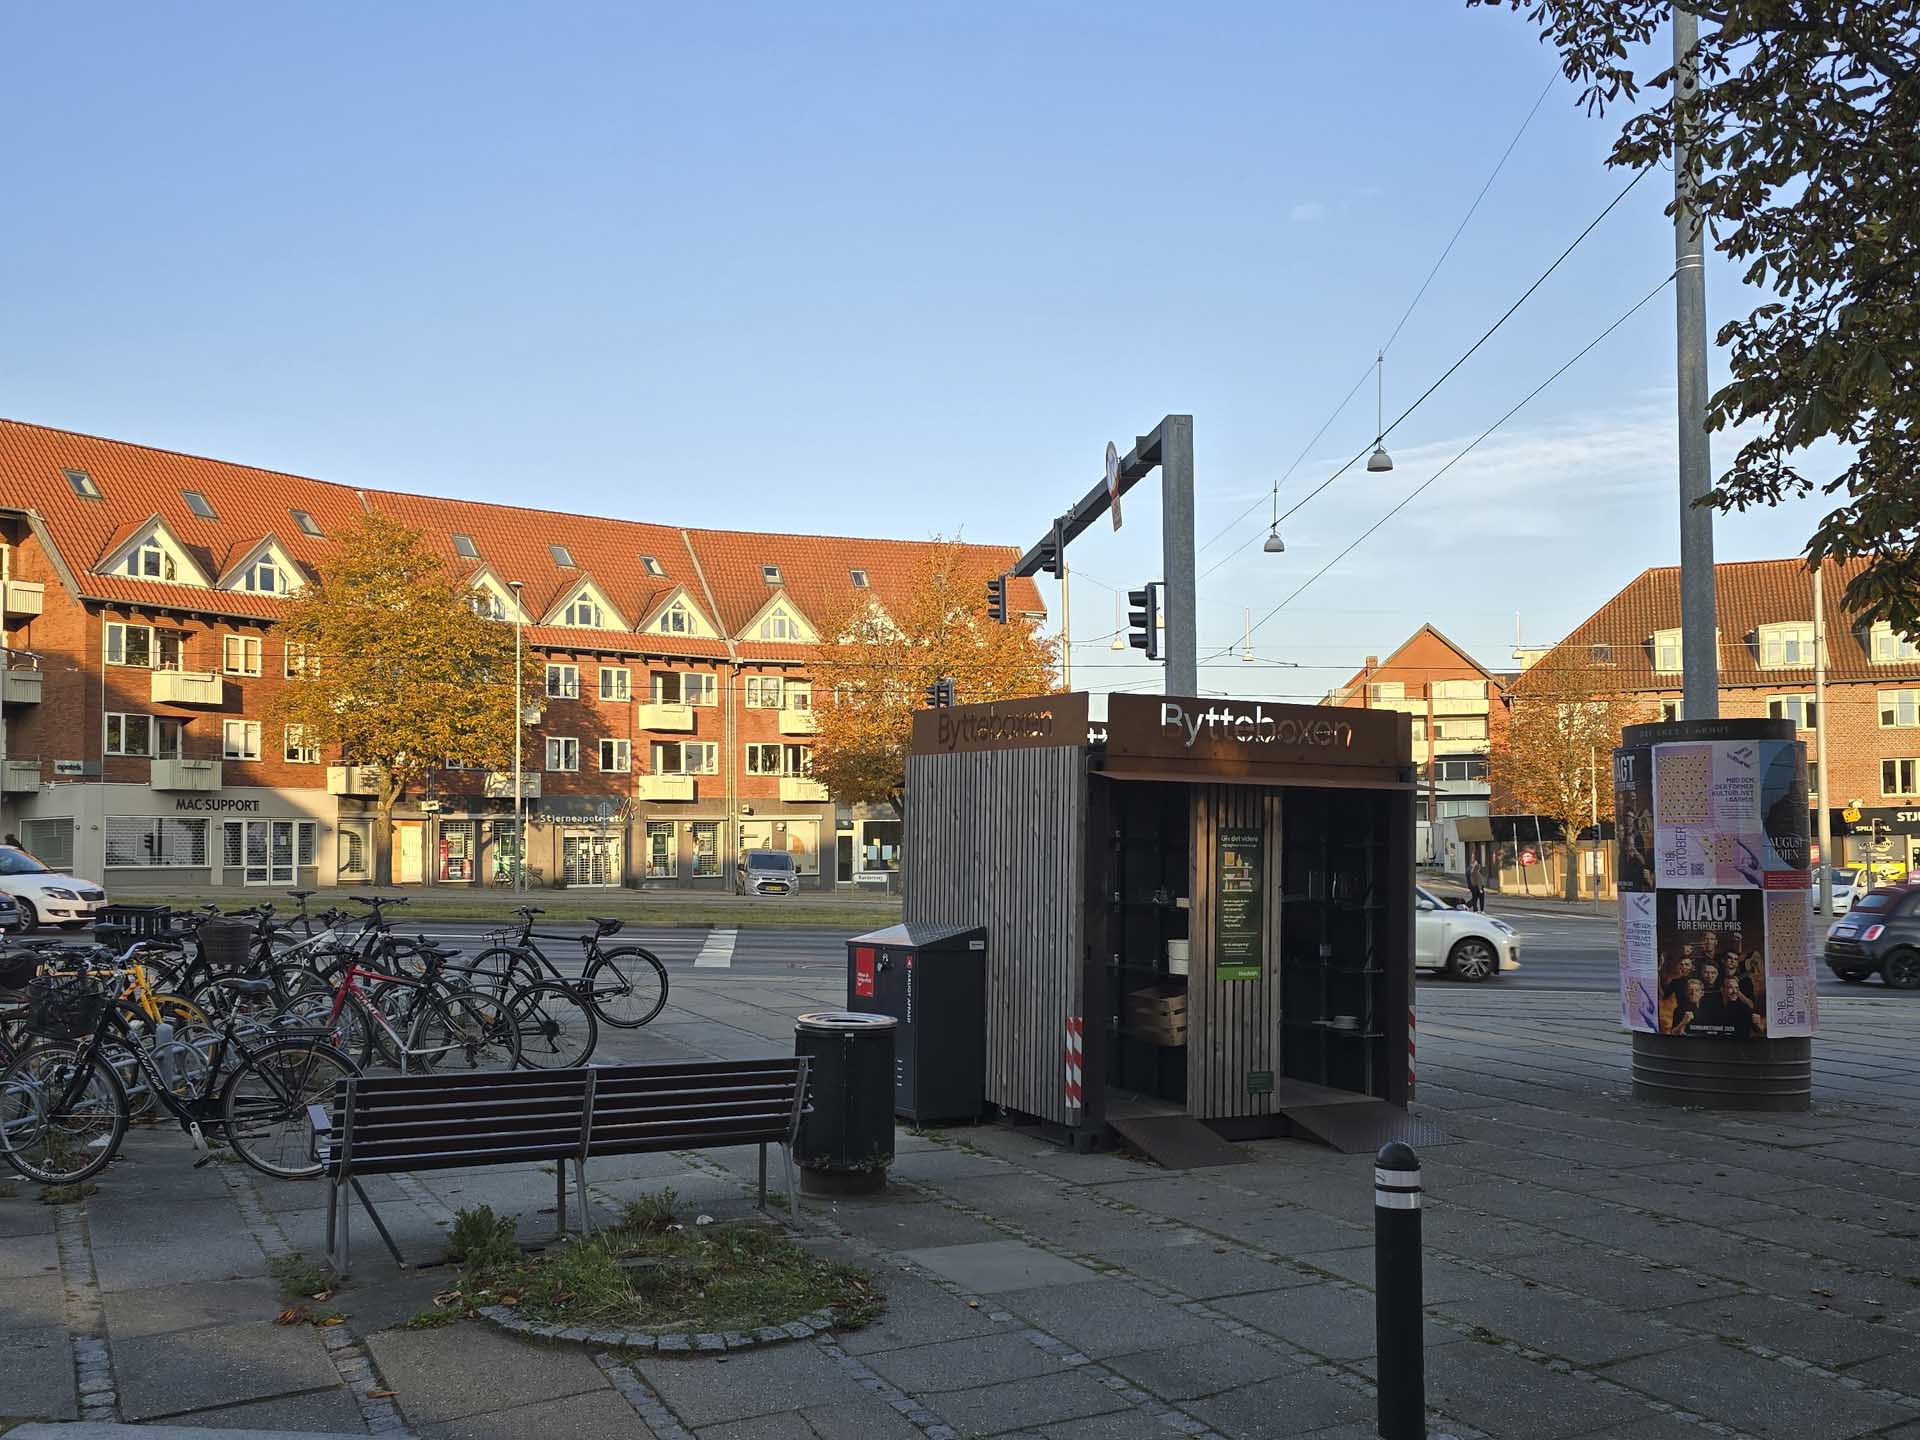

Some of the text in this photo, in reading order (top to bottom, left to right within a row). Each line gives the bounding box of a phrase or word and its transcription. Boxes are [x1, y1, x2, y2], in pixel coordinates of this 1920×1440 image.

[938, 704, 1053, 749] Bytteboxen
[1161, 702, 1352, 747] Bytteboxen
[1615, 755, 1635, 782] AGT
[540, 814, 620, 824] Stjerneapoteet
[1675, 827, 1688, 876] OKTOBER
[1677, 894, 1741, 921] MAGT
[1677, 920, 1742, 931] FOR ENHVER PRIS
[1784, 974, 1795, 1025] OKTOBER
